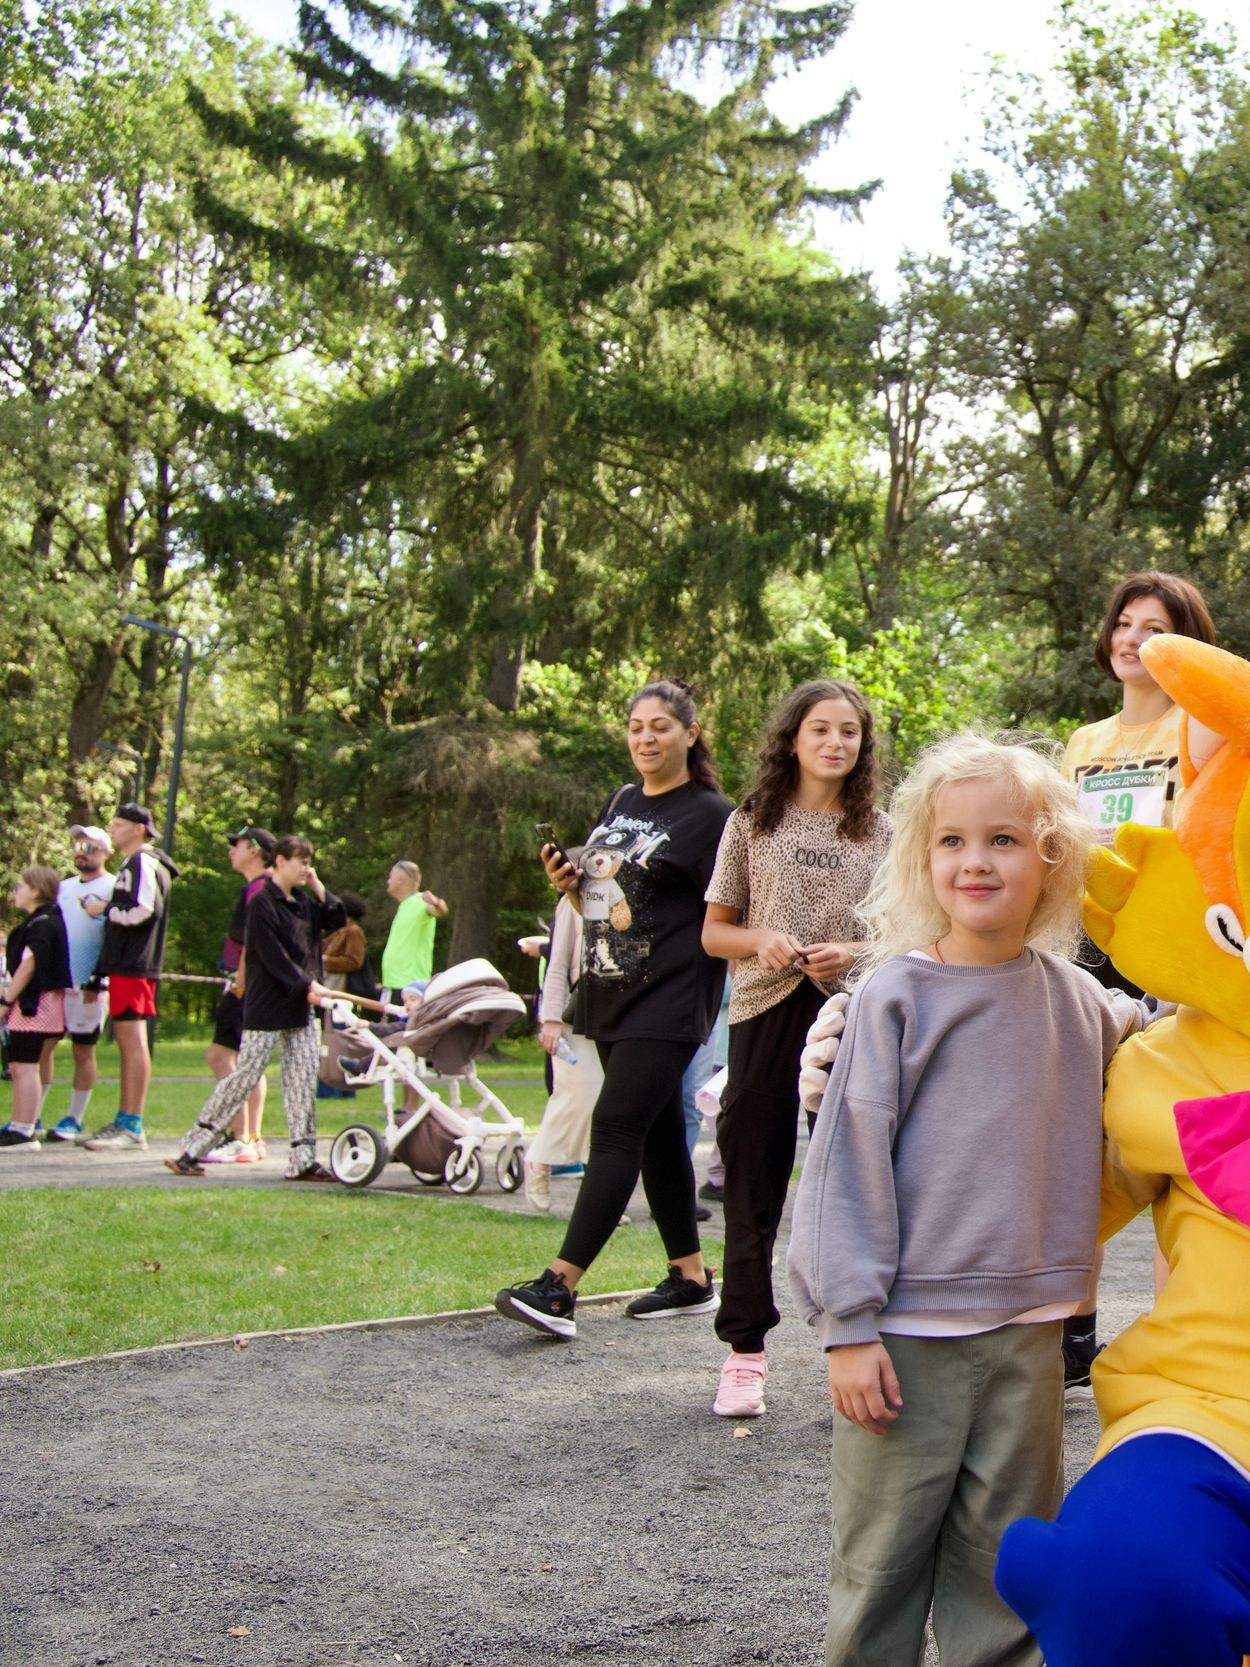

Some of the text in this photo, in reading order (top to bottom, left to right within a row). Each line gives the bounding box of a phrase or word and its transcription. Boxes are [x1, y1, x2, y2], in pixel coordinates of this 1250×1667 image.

[1089, 774, 1156, 789] КРОСС ДУБКИ
[1101, 792, 1133, 824] 39
[795, 848, 840, 869] COCO
